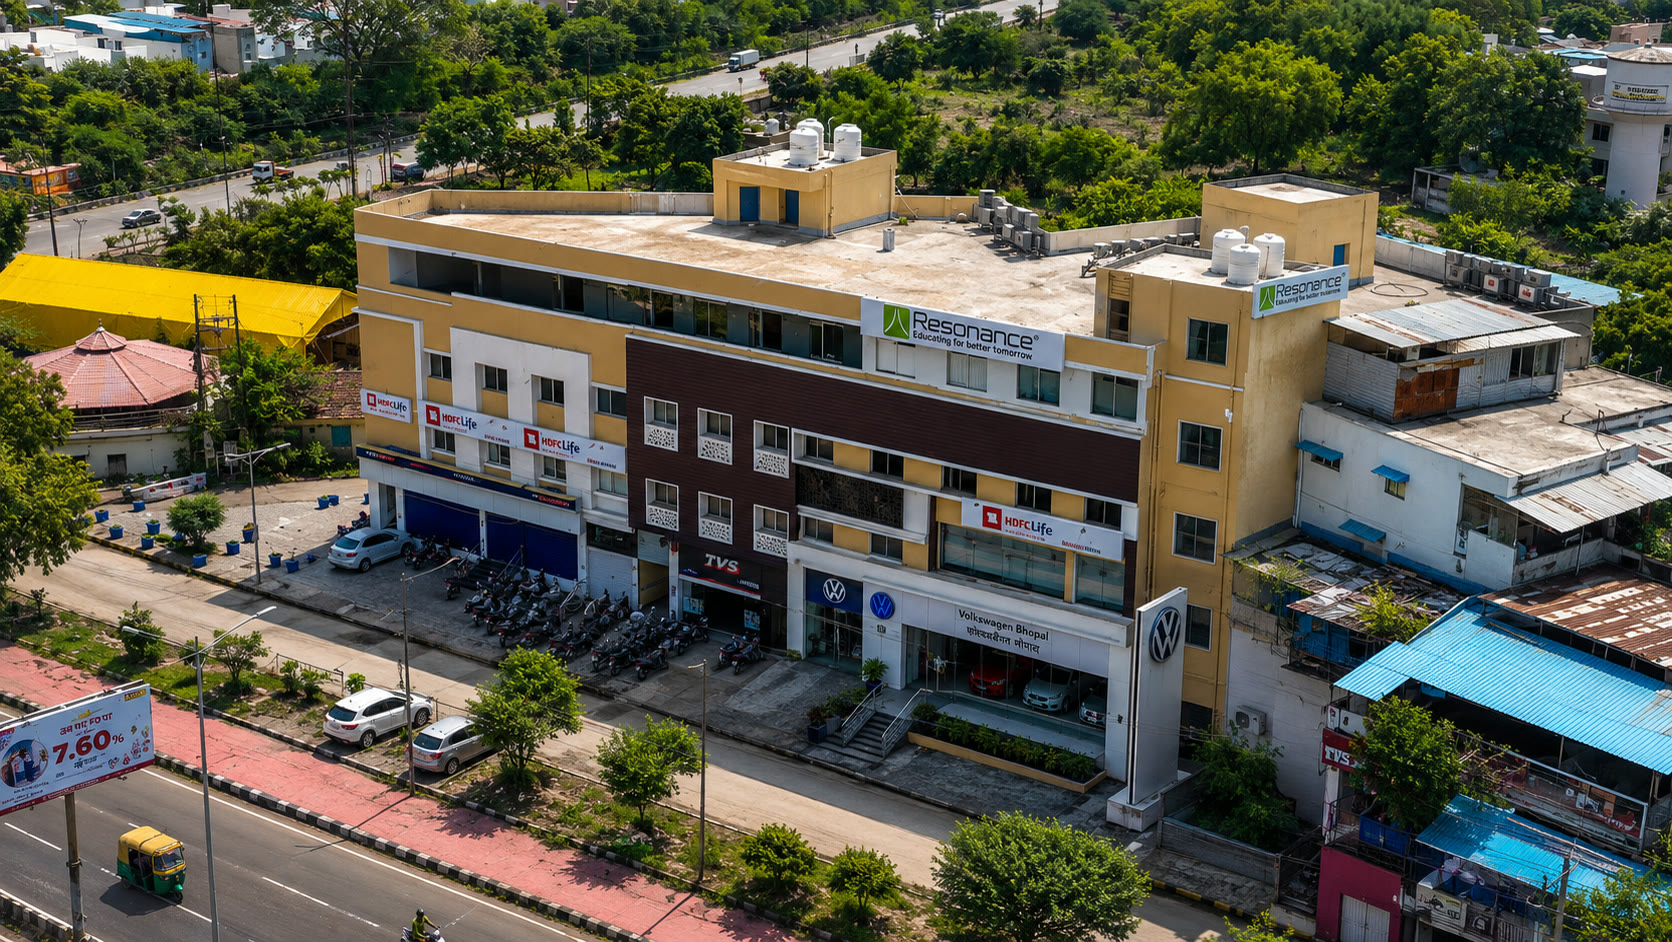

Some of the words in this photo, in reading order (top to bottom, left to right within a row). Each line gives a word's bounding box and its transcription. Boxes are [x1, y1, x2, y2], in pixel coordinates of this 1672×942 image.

[1276, 276, 1341, 298] Resonance
[913, 311, 1033, 351] Resonance
[913, 330, 951, 347] Educating
[953, 337, 965, 349] for
[966, 341, 991, 353] better
[993, 345, 1033, 360] tomorrow
[705, 553, 740, 574] TVS
[959, 609, 1013, 631] Volkswagen
[1016, 624, 1049, 641] Bhopal
